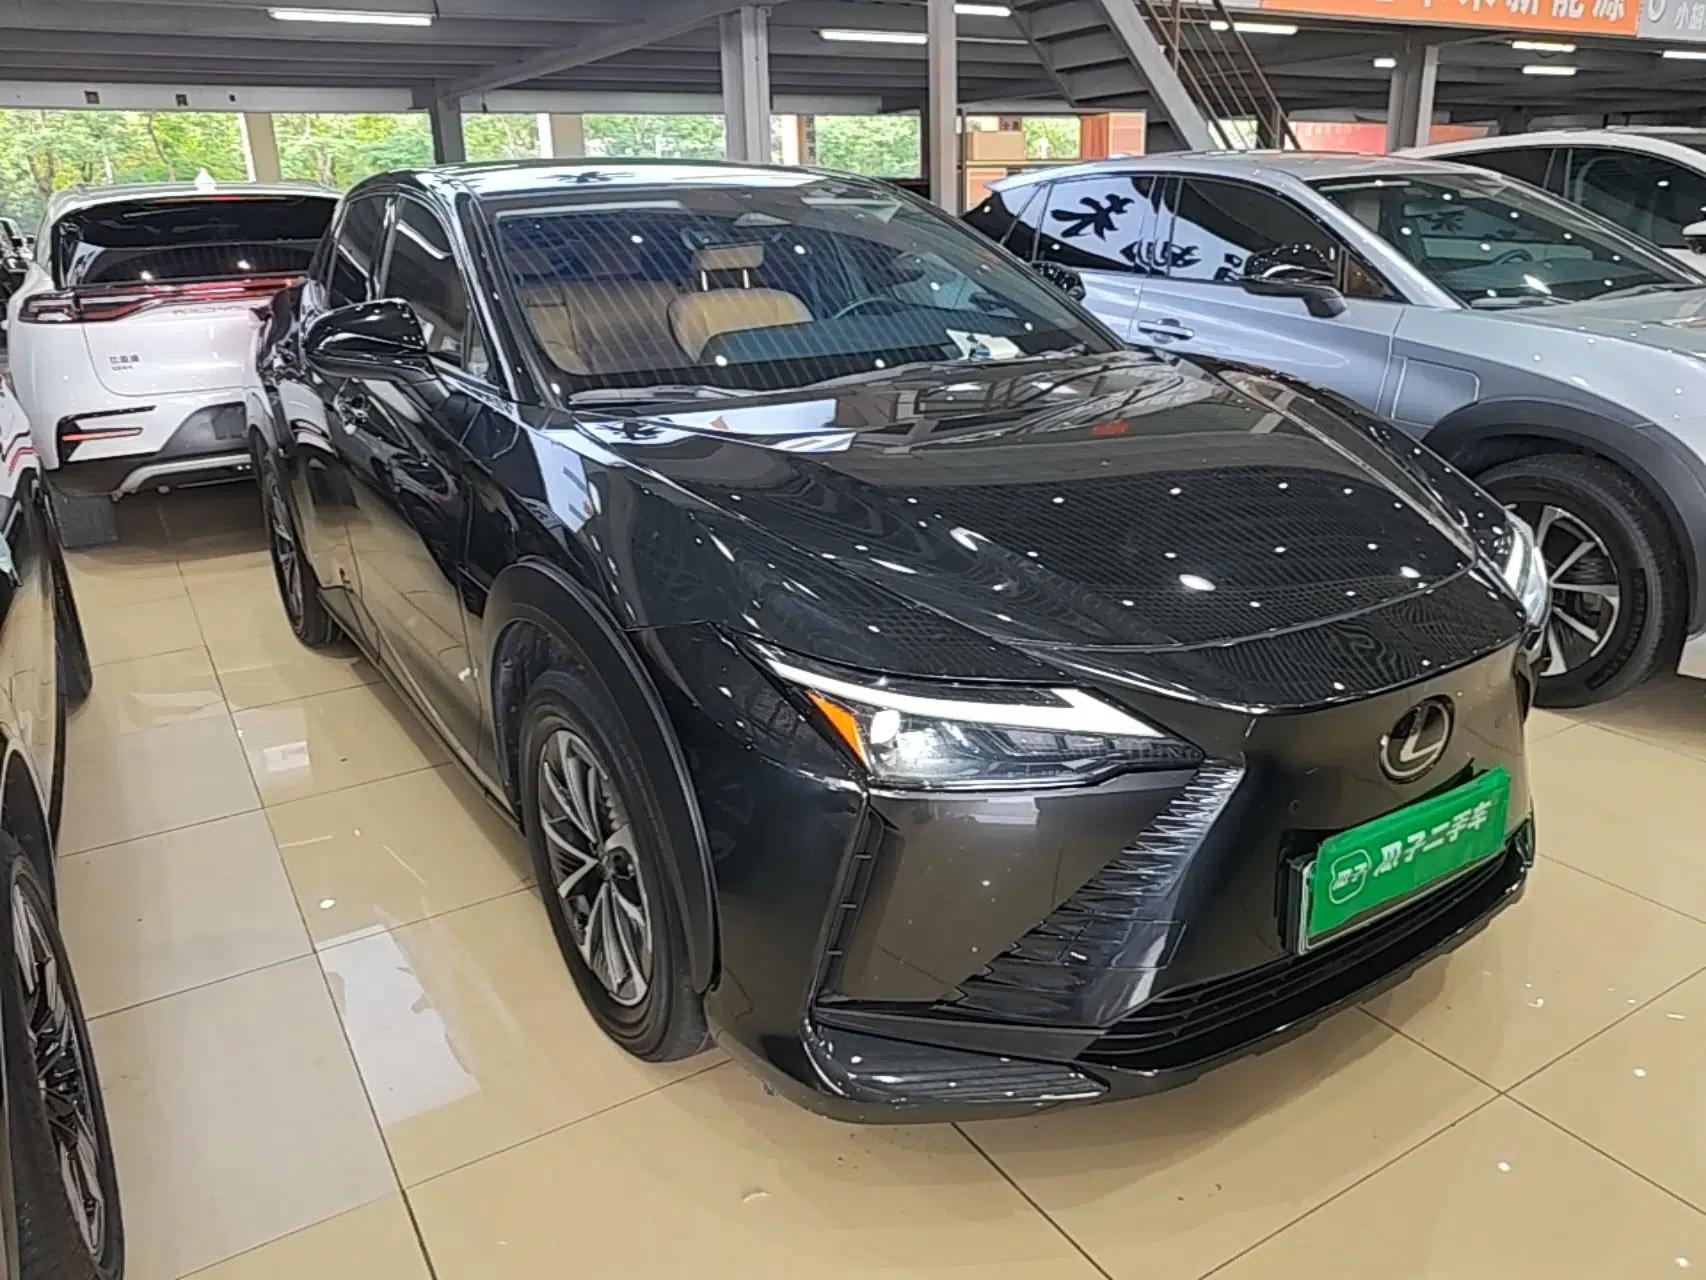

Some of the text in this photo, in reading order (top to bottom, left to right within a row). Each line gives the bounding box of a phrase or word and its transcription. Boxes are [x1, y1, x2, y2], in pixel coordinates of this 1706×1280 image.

[1372, 800, 1493, 877] 瓜子二手车
